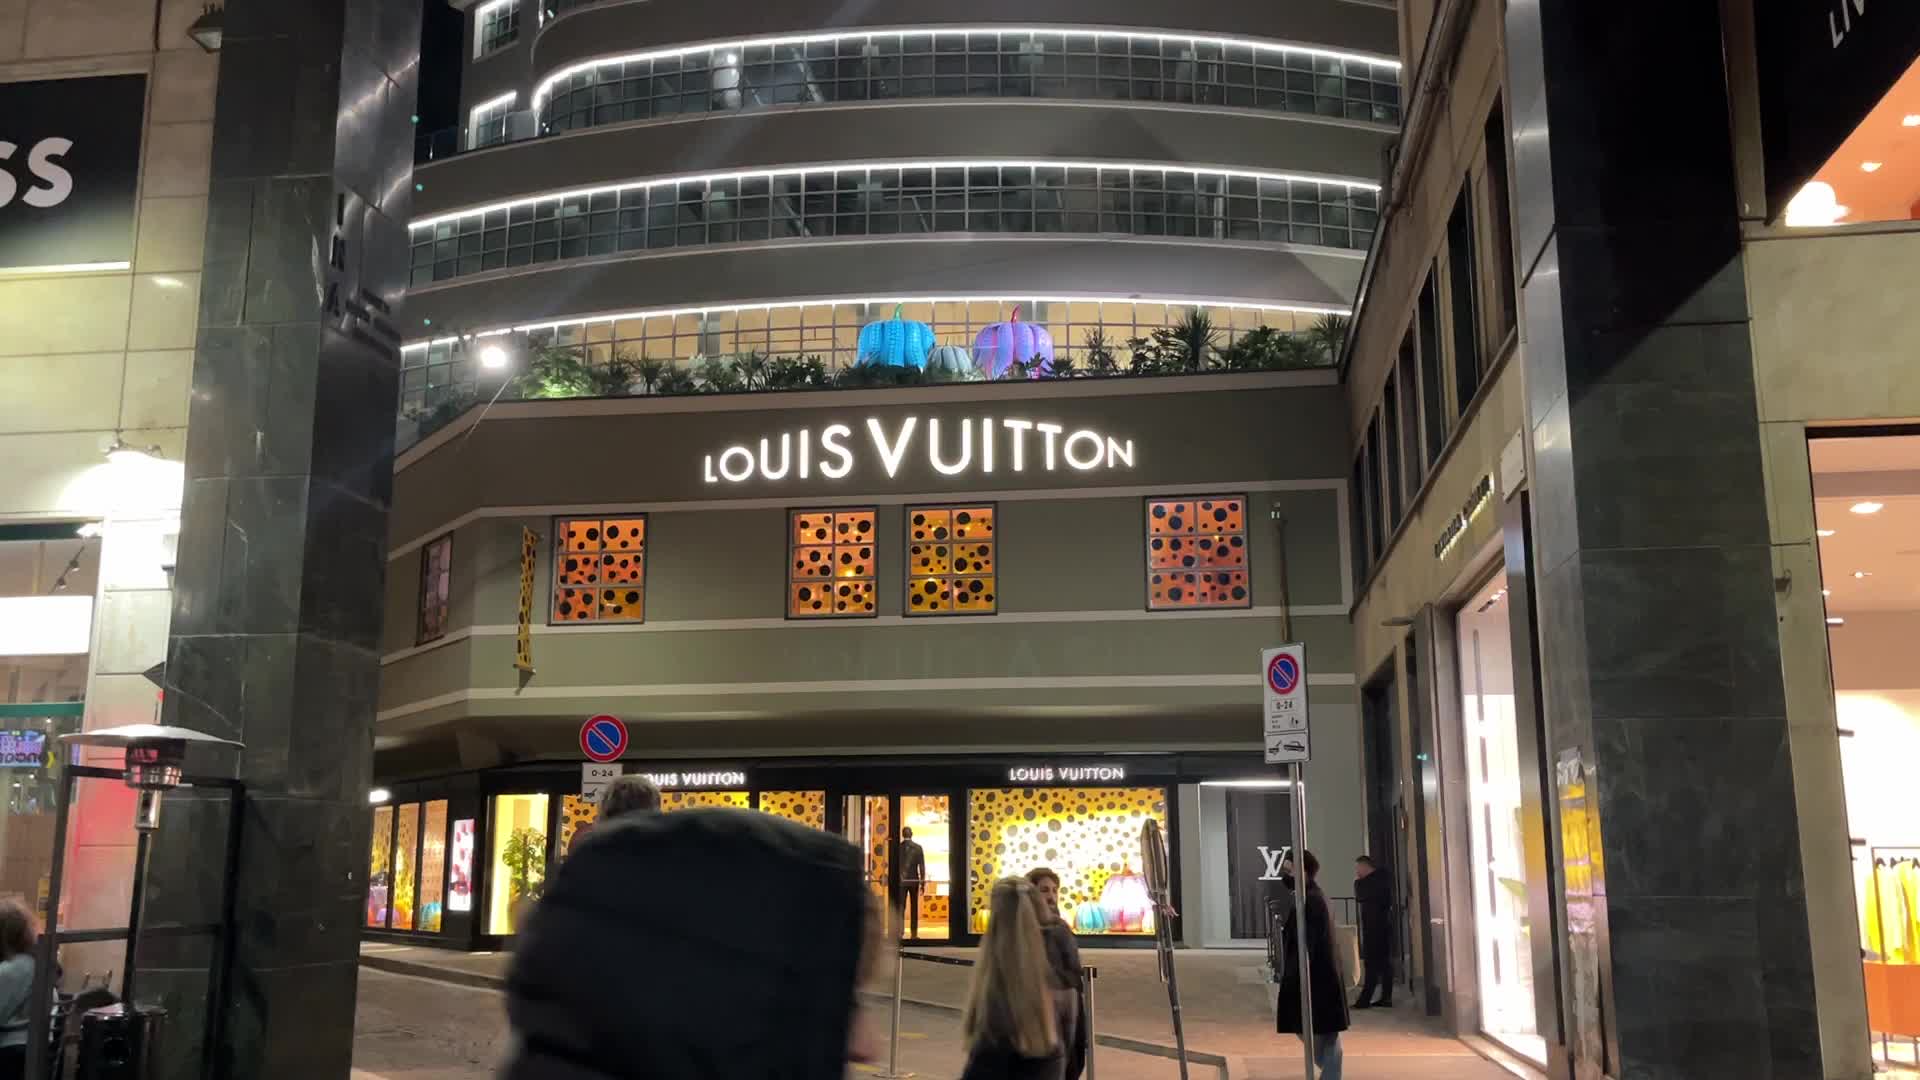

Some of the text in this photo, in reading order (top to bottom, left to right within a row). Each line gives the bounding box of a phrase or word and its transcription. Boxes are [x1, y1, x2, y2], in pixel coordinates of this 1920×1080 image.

[704, 416, 1134, 483] LOUIS VUITTON
[591, 769, 614, 777] 0-24
[646, 772, 745, 786] OUIS VUITTON
[1009, 766, 1124, 781] LOUIS VUITTON
